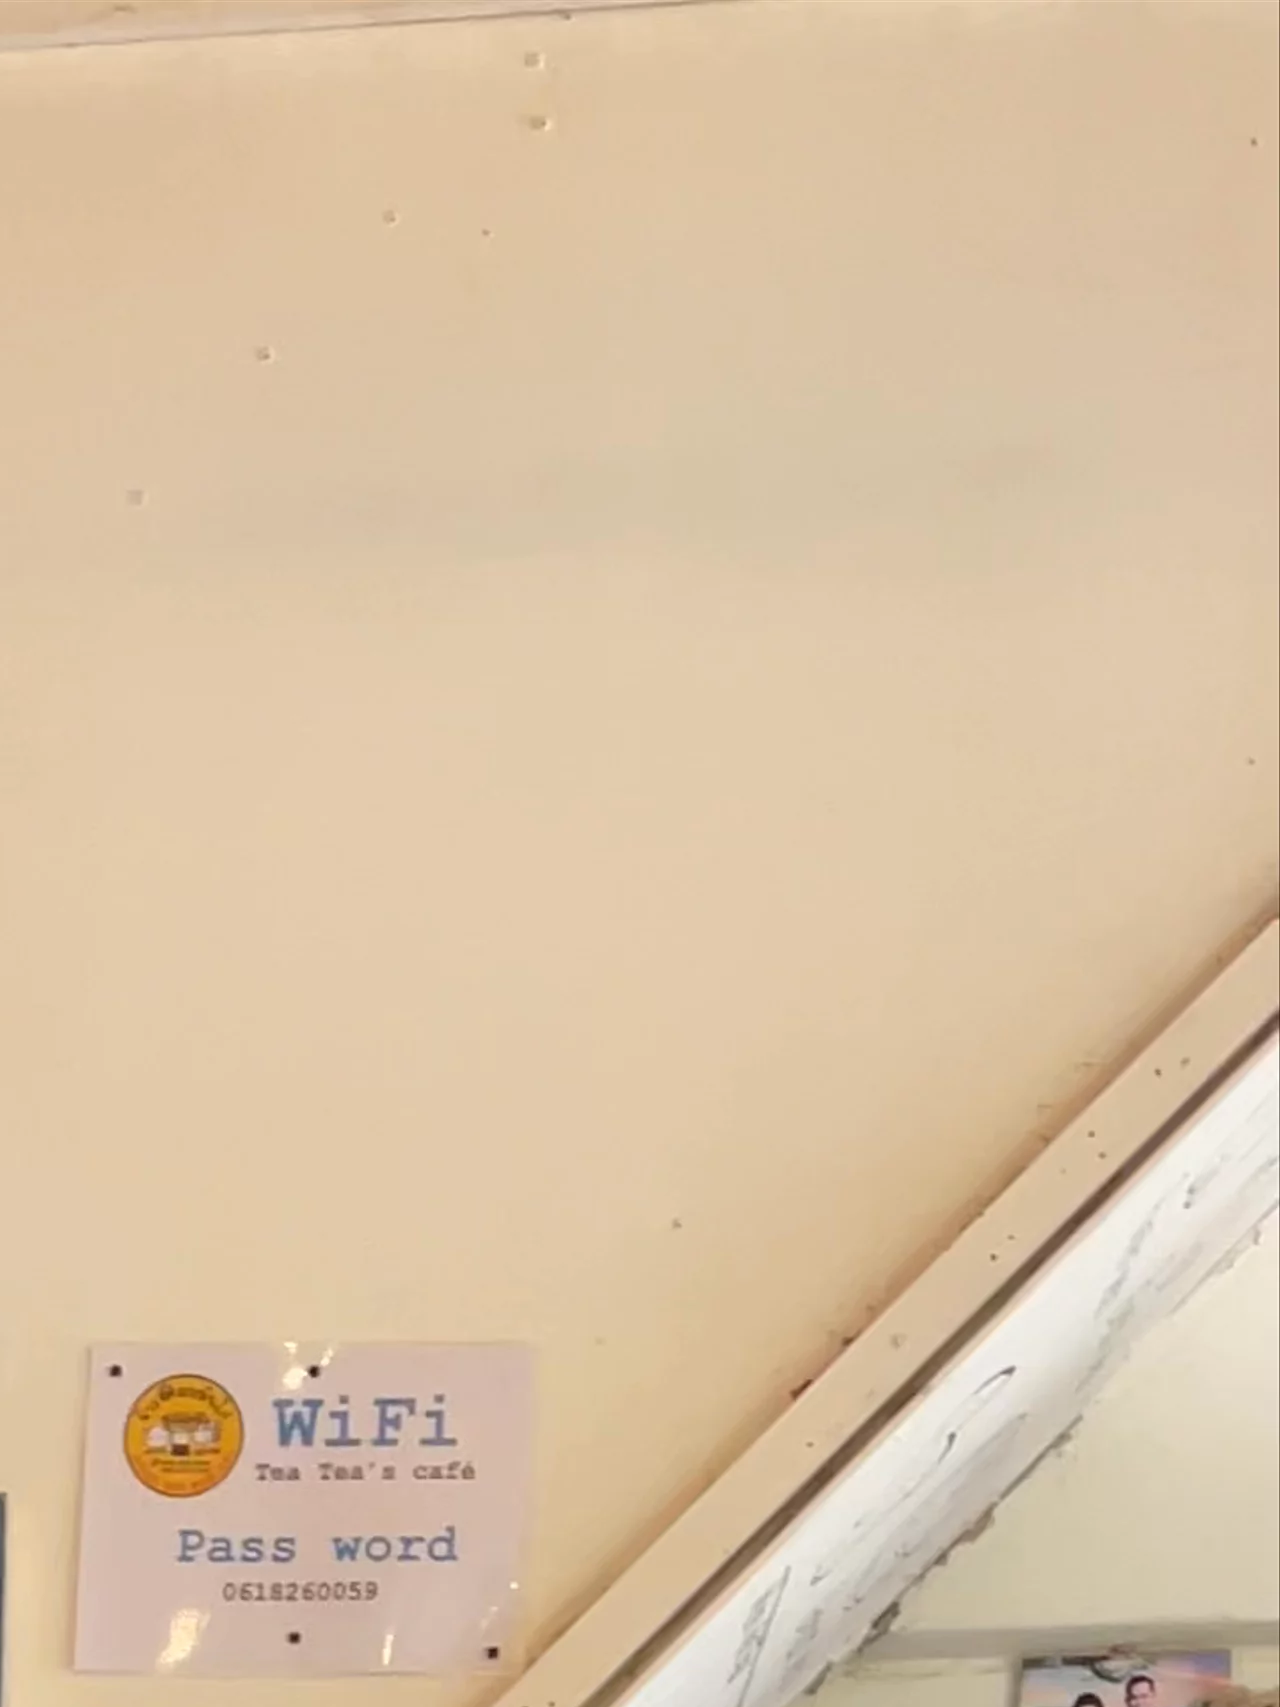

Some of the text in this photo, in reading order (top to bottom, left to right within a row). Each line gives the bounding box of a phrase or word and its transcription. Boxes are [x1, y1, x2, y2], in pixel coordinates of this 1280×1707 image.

[272, 1394, 458, 1448] WiFi
[412, 1460, 476, 1481] café
[176, 1525, 459, 1563] Pass word
[221, 1581, 380, 1602] 0618260059
